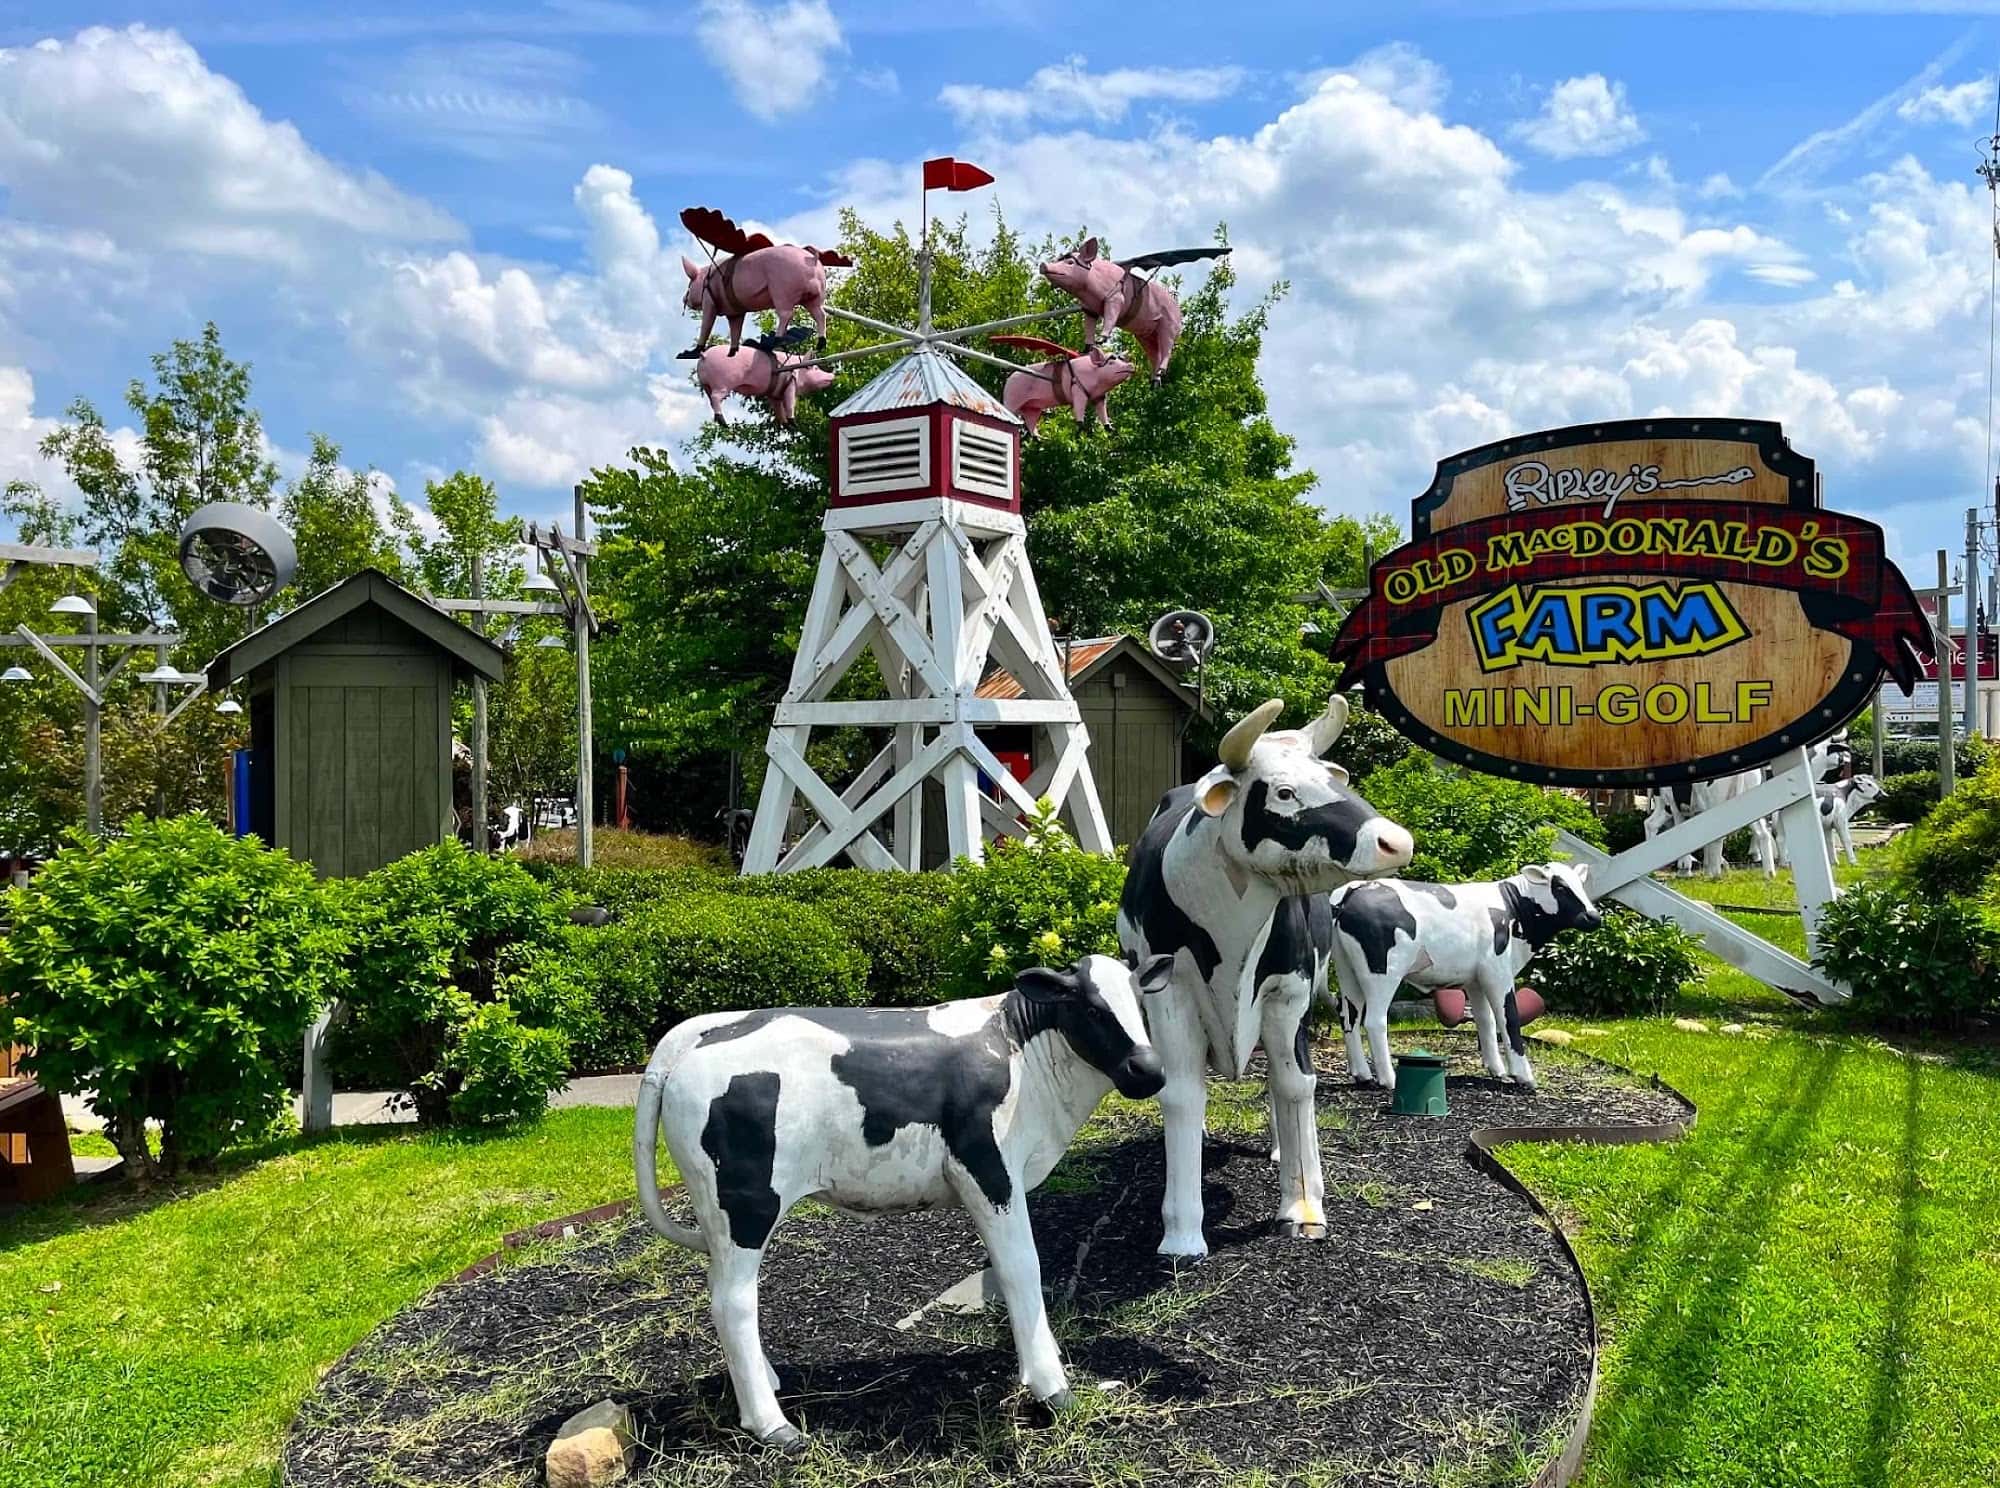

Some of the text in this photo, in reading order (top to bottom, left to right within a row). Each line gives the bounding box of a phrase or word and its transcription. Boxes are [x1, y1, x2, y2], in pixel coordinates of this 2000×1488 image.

[1384, 548, 1475, 604] OLD
[1472, 587, 1740, 664] FARM
[1444, 681, 1773, 726] MINI-GOLF
